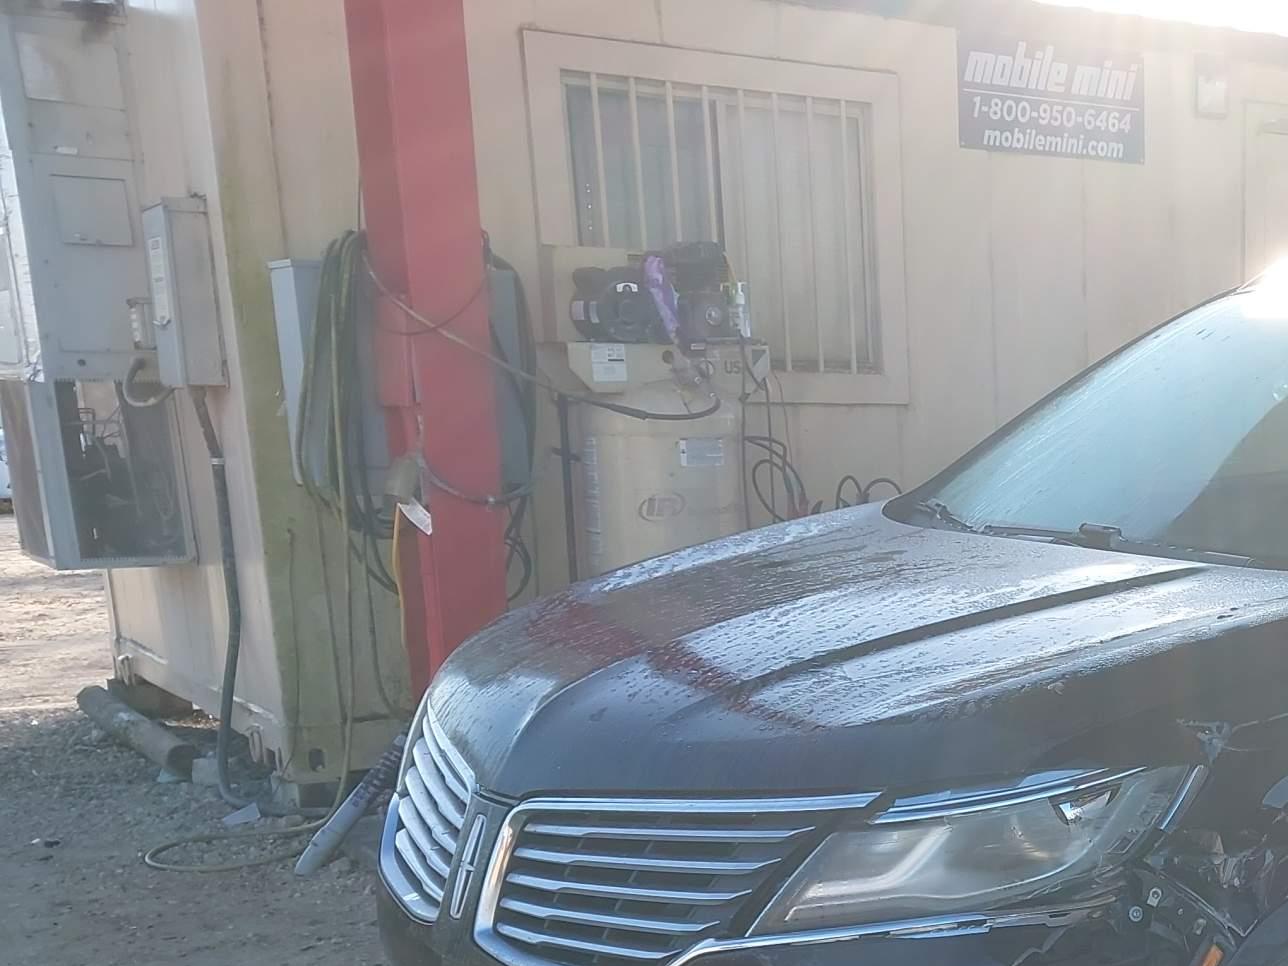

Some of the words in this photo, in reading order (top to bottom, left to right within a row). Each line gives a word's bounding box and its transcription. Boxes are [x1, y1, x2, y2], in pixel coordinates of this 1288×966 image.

[964, 41, 1068, 92] mobile
[1071, 60, 1138, 100] mini
[973, 96, 1131, 133] 1-800-950-6464
[983, 128, 1124, 158] mobilemini.com
